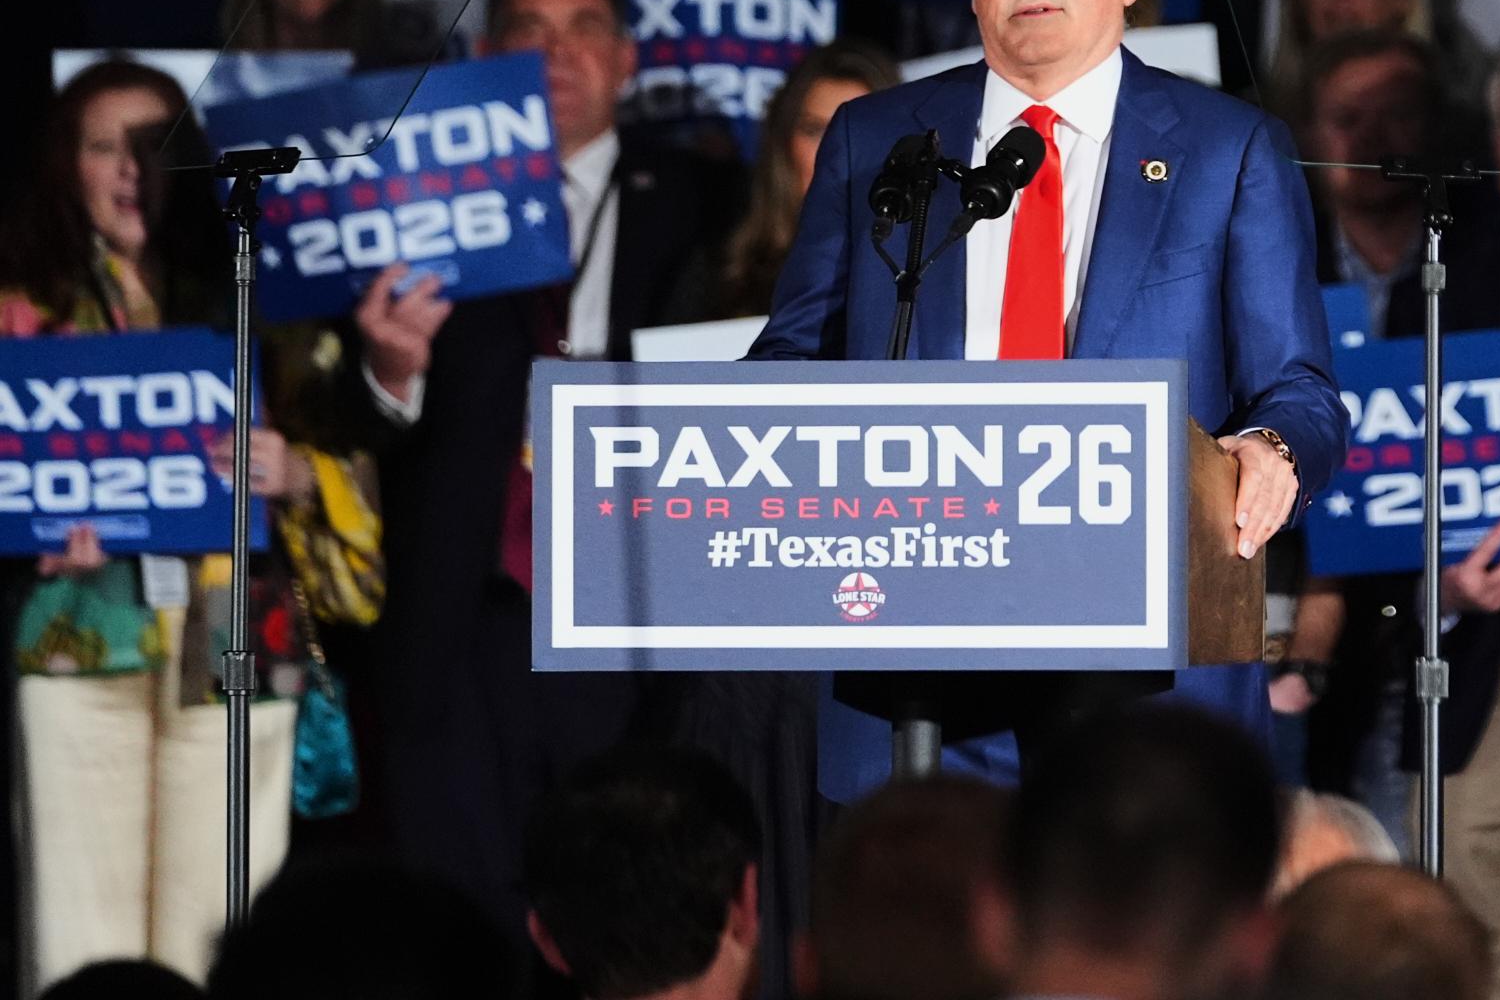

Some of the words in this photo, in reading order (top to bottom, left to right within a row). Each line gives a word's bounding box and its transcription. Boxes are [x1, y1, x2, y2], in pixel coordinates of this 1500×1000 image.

[287, 189, 512, 277] 2026
[0, 369, 254, 432] AXTON
[0, 454, 207, 513] 2026
[589, 424, 1003, 488] PAXTON
[1017, 423, 1132, 525] 26
[1345, 443, 1413, 472] OR
[632, 497, 730, 519] FOR
[761, 496, 966, 519] SENATE
[707, 523, 1010, 568] #TexasFirst
[832, 591, 859, 604] LONE
[860, 591, 886, 604] STAR
